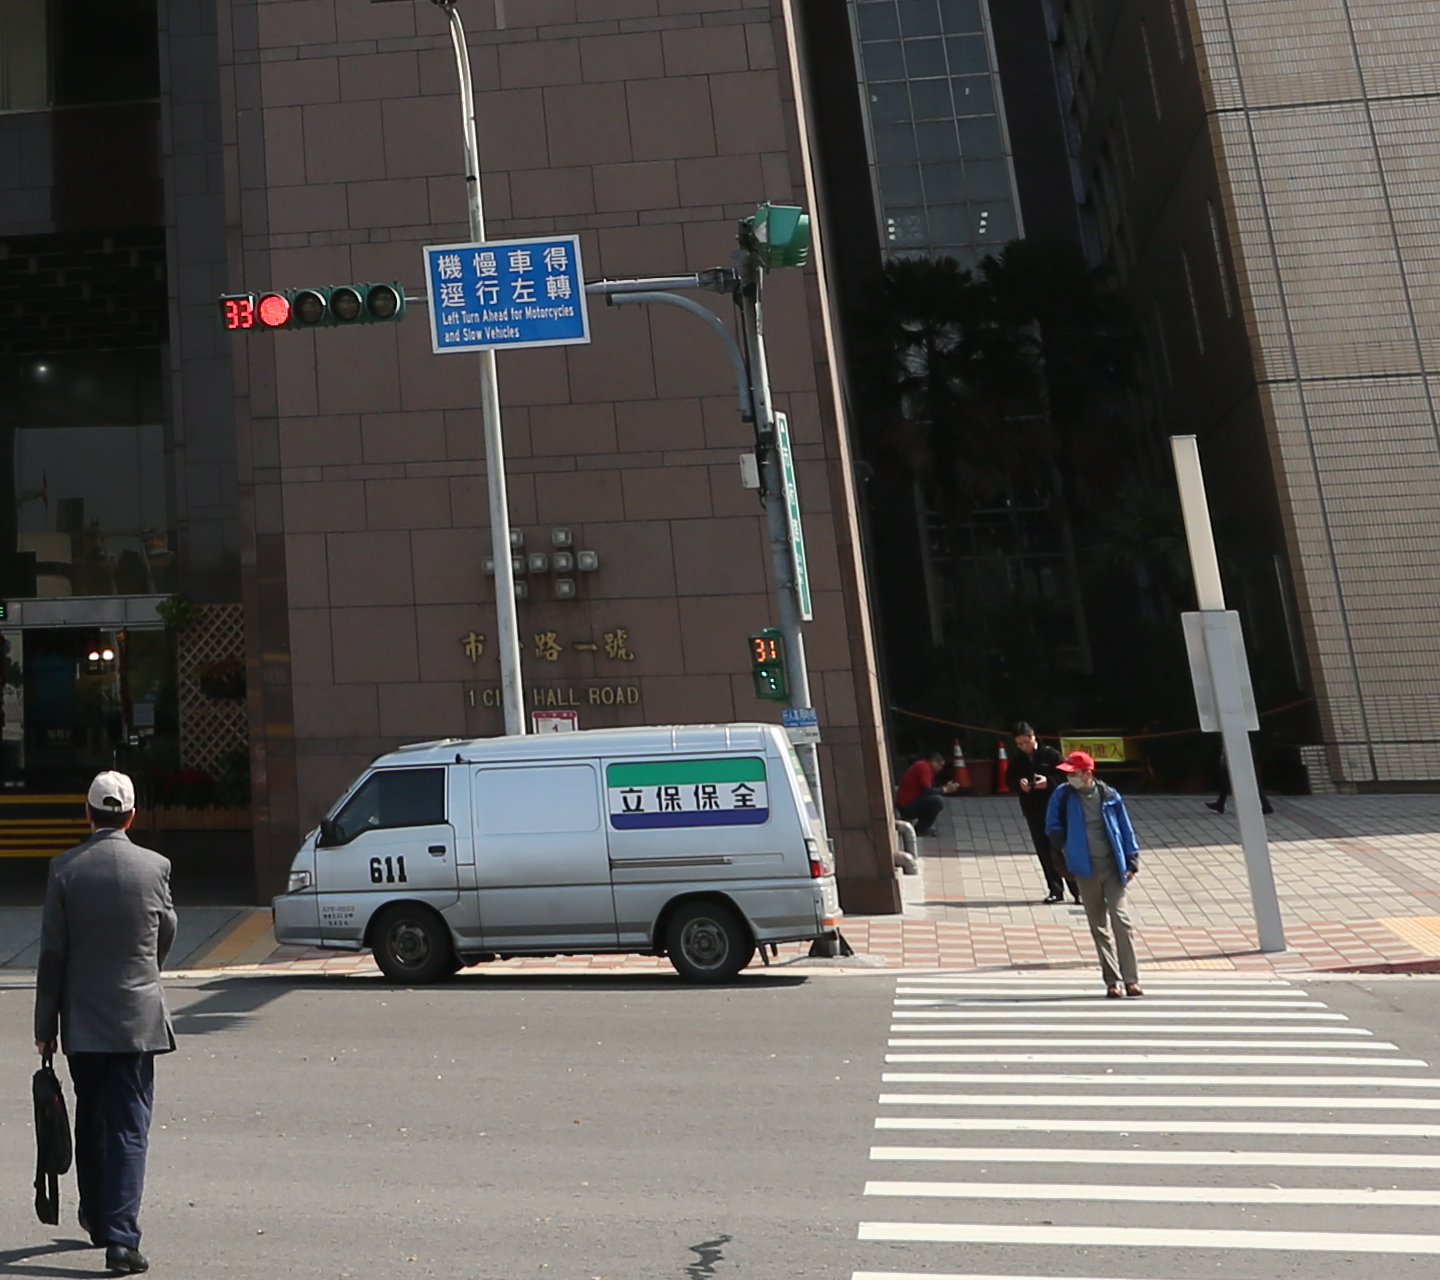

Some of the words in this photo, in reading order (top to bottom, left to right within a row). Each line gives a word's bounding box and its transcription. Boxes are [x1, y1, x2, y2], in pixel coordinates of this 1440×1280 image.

[437, 246, 569, 280] 機慢車得
[439, 274, 572, 308] 逕行左轉
[225, 299, 253, 329] 33
[442, 311, 459, 325] Left
[462, 310, 480, 323] Turn
[482, 308, 508, 322] Ahead
[511, 307, 523, 320] for
[525, 304, 574, 320] Motorcycles
[444, 329, 460, 342] and
[462, 327, 483, 341] Slow
[484, 326, 520, 340] Vehicles
[461, 629, 635, 662] 市路一號
[533, 688, 580, 706] HALL
[589, 686, 639, 705] ROAD
[619, 781, 759, 814] 立保保全
[369, 855, 408, 884] 611
